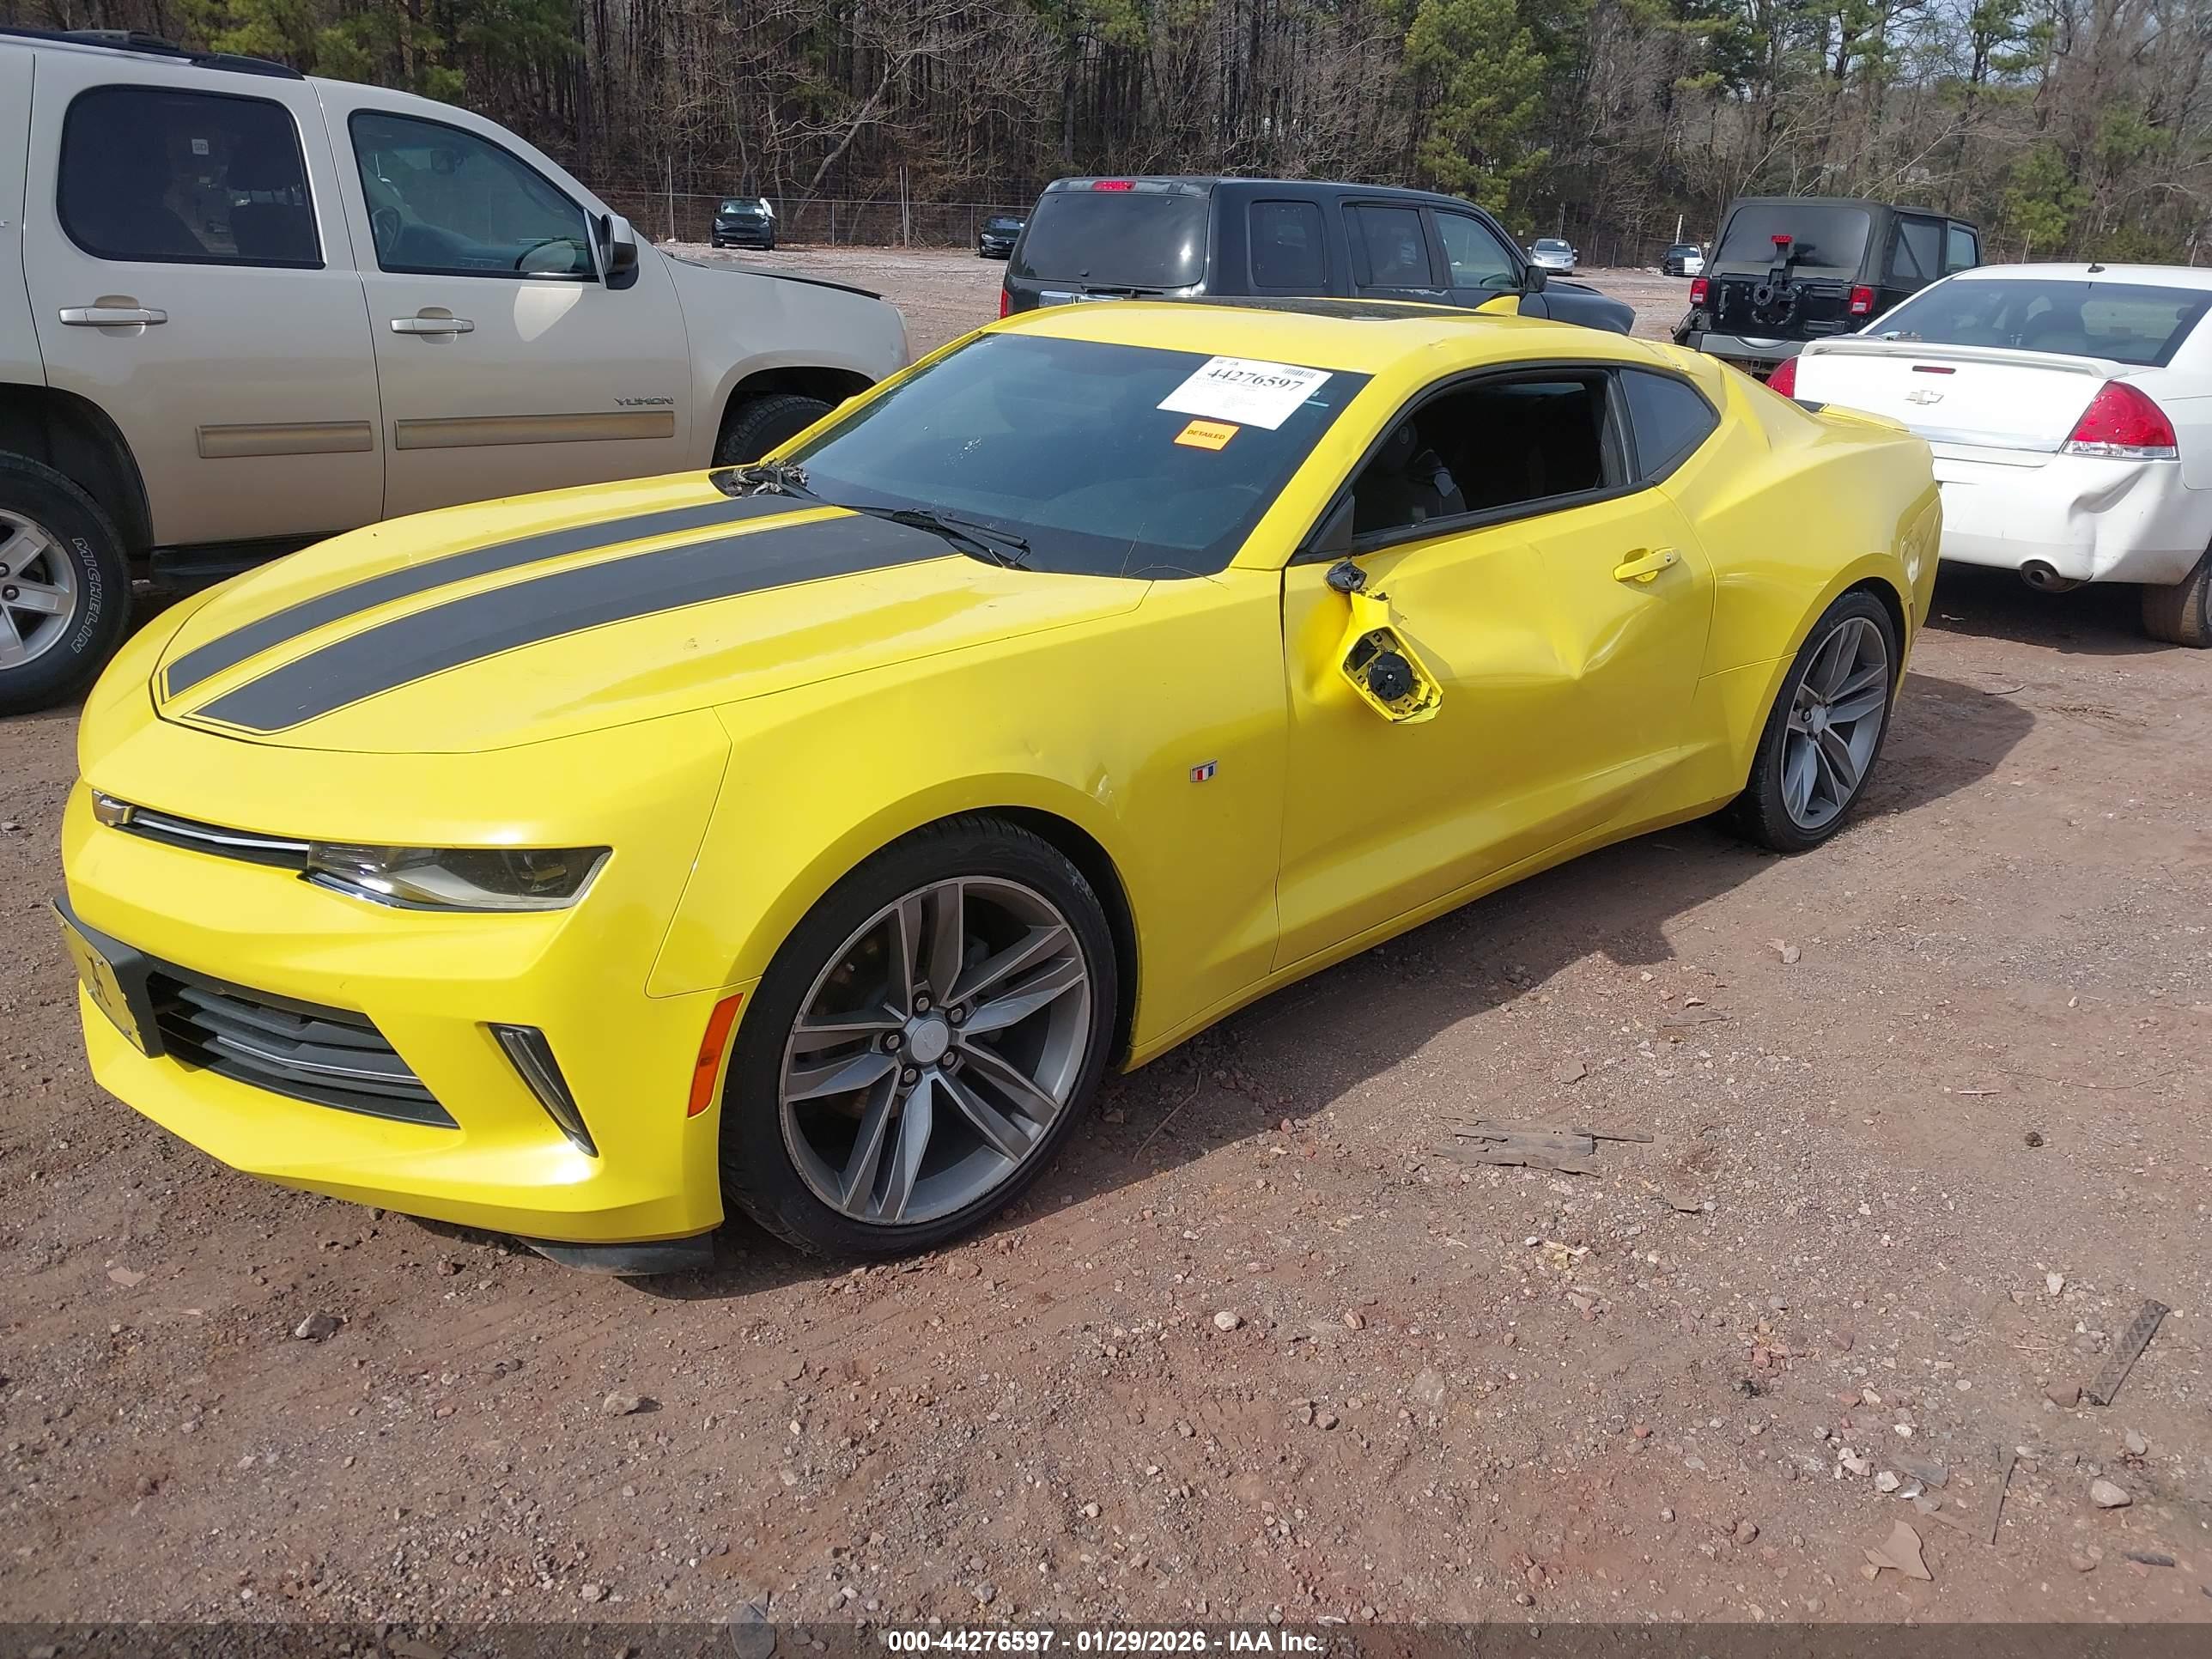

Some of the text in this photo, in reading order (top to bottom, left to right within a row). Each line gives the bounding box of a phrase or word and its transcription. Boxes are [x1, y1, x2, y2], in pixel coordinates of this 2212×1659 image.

[1207, 368, 1305, 392] 44276597
[613, 397, 674, 406] YUKON
[1187, 429, 1225, 440] DETAILED
[70, 538, 103, 653] MICHELIN
